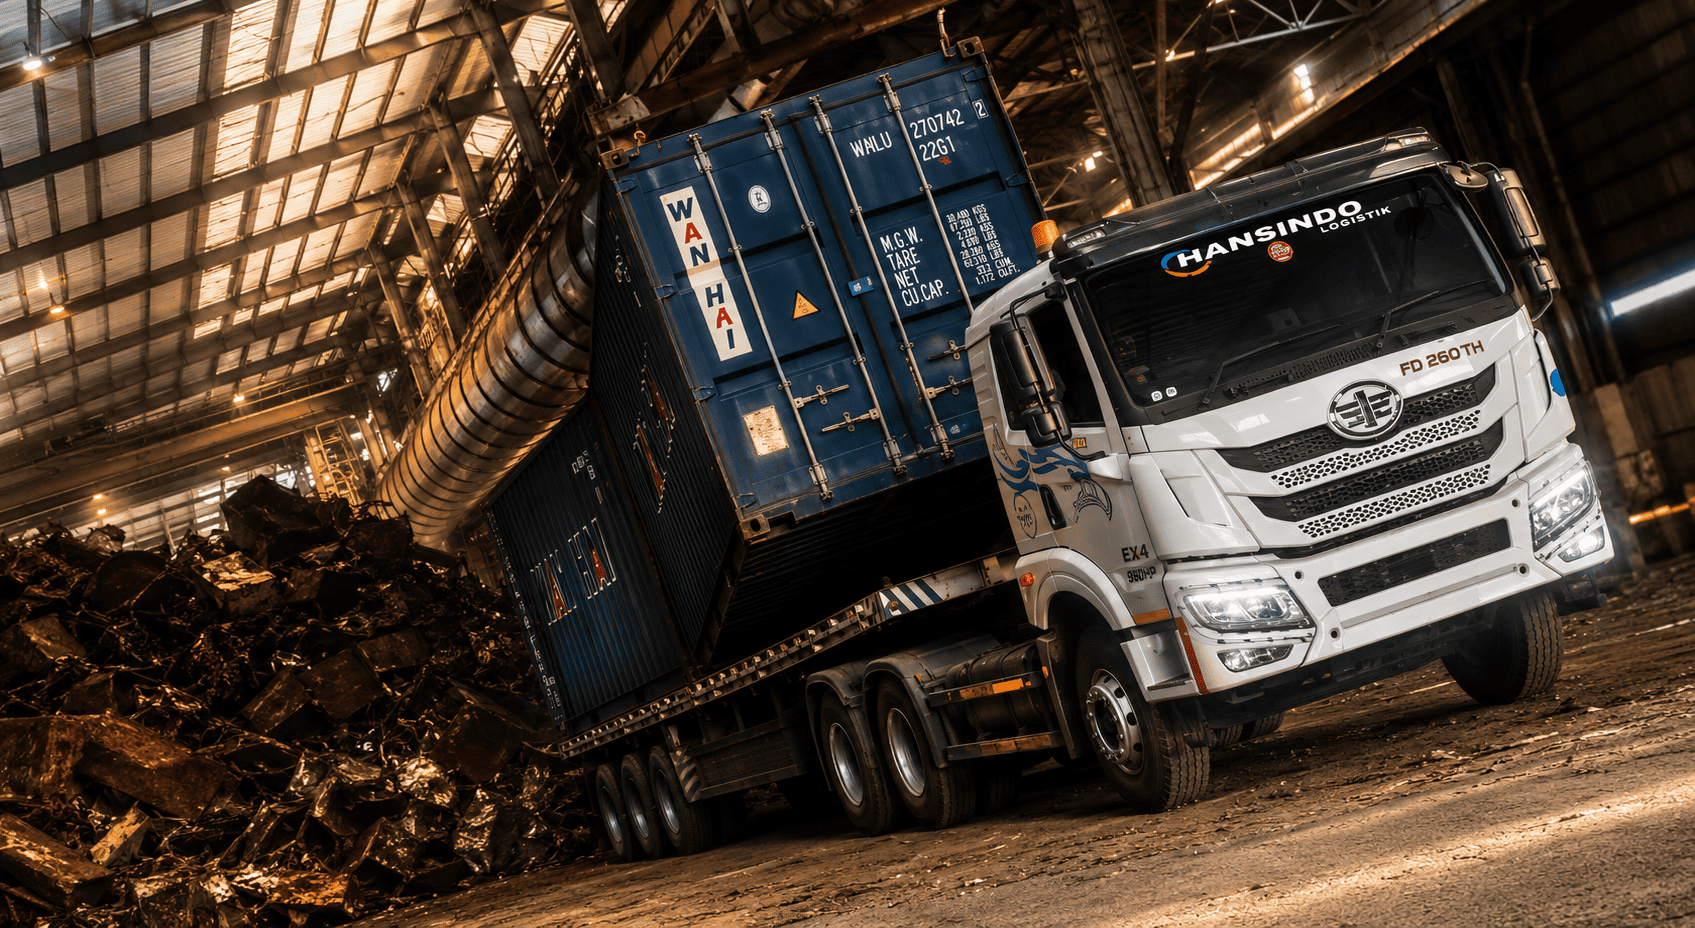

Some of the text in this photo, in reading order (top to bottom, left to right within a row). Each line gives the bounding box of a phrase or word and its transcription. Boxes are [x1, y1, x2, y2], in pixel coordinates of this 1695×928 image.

[850, 100, 988, 157] WALU 270742 2
[919, 136, 955, 161] 22G1
[1320, 205, 1391, 234] LOGISTIK
[880, 226, 923, 253] M.G.W.
[1176, 200, 1362, 268] HANSINDO
[886, 247, 920, 270] TARE
[667, 197, 735, 350] WAN HAI
[894, 266, 919, 289] NET
[901, 279, 949, 306] CU.CAP.
[1399, 358, 1424, 377] FD
[1121, 544, 1150, 563] EX4
